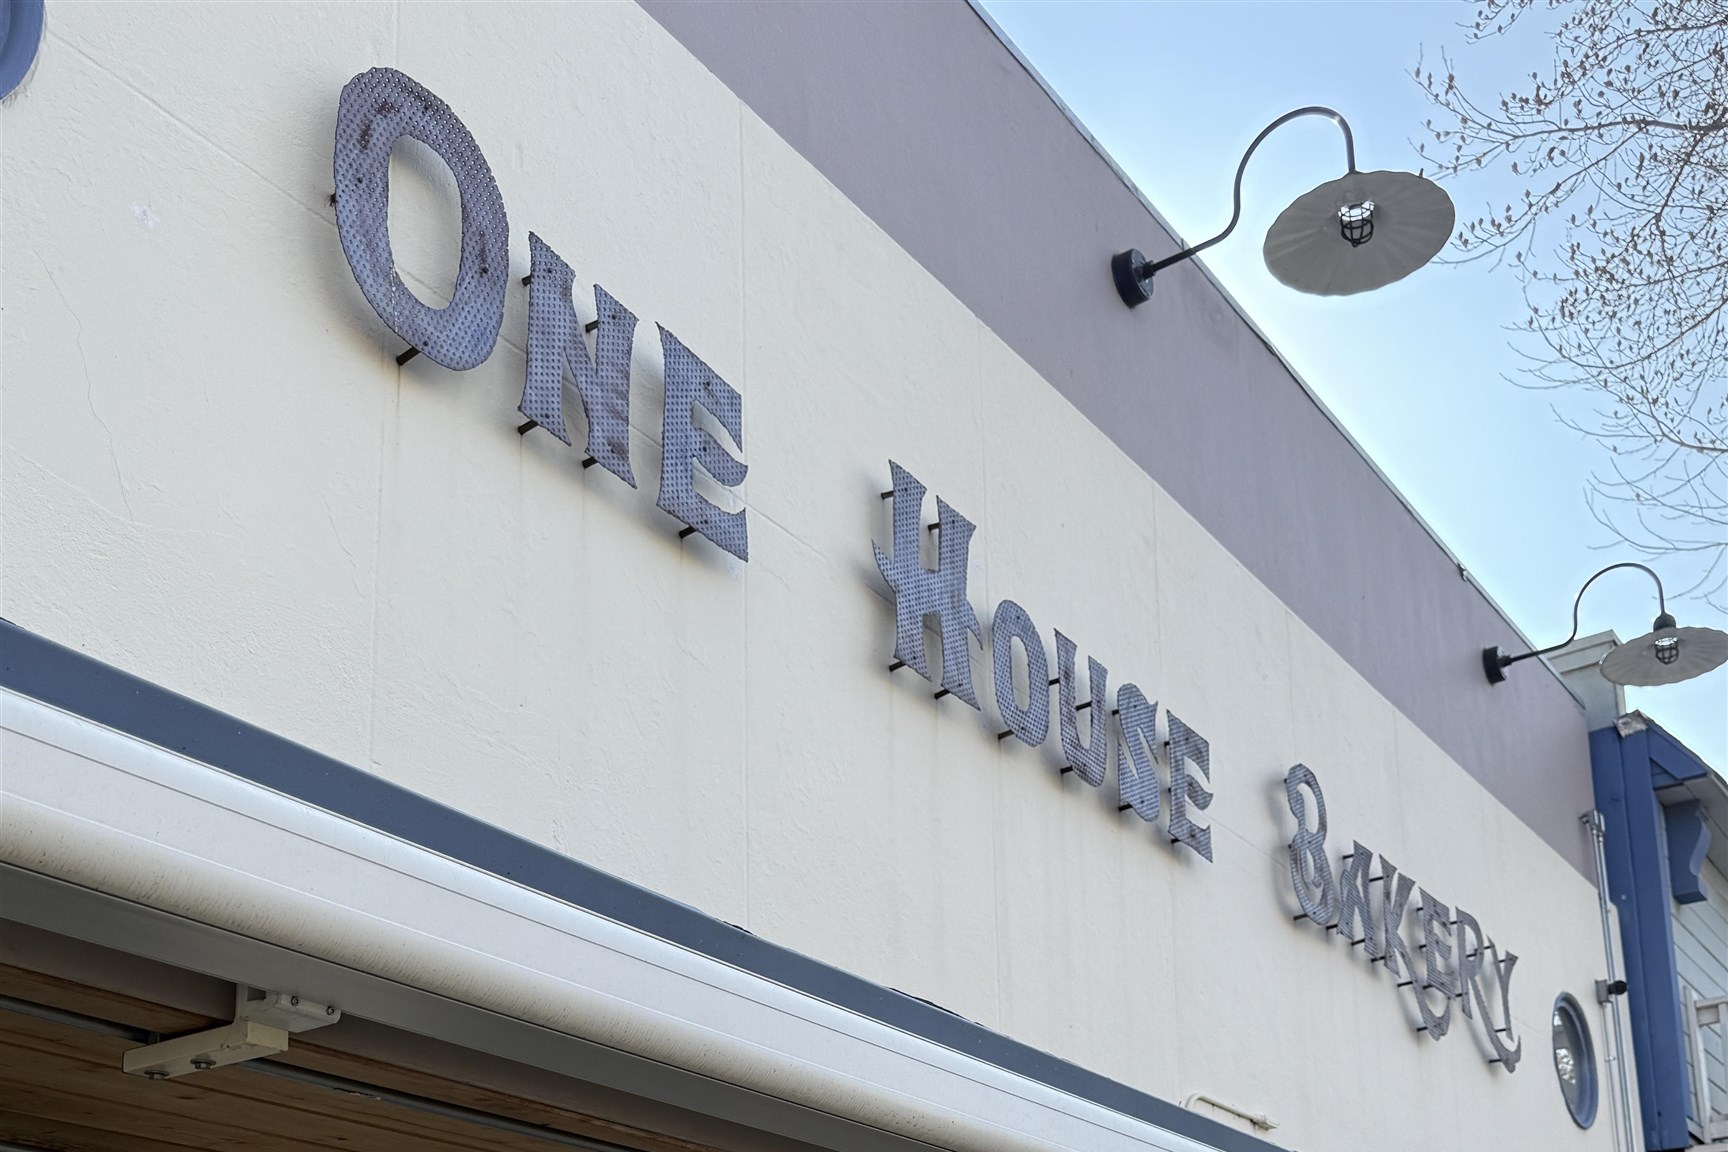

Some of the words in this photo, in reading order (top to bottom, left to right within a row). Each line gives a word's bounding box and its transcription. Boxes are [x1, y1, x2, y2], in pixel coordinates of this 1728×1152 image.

[334, 66, 750, 563] ONE
[871, 458, 1215, 864] HOUSE
[1286, 762, 1522, 1074] BAKERY
